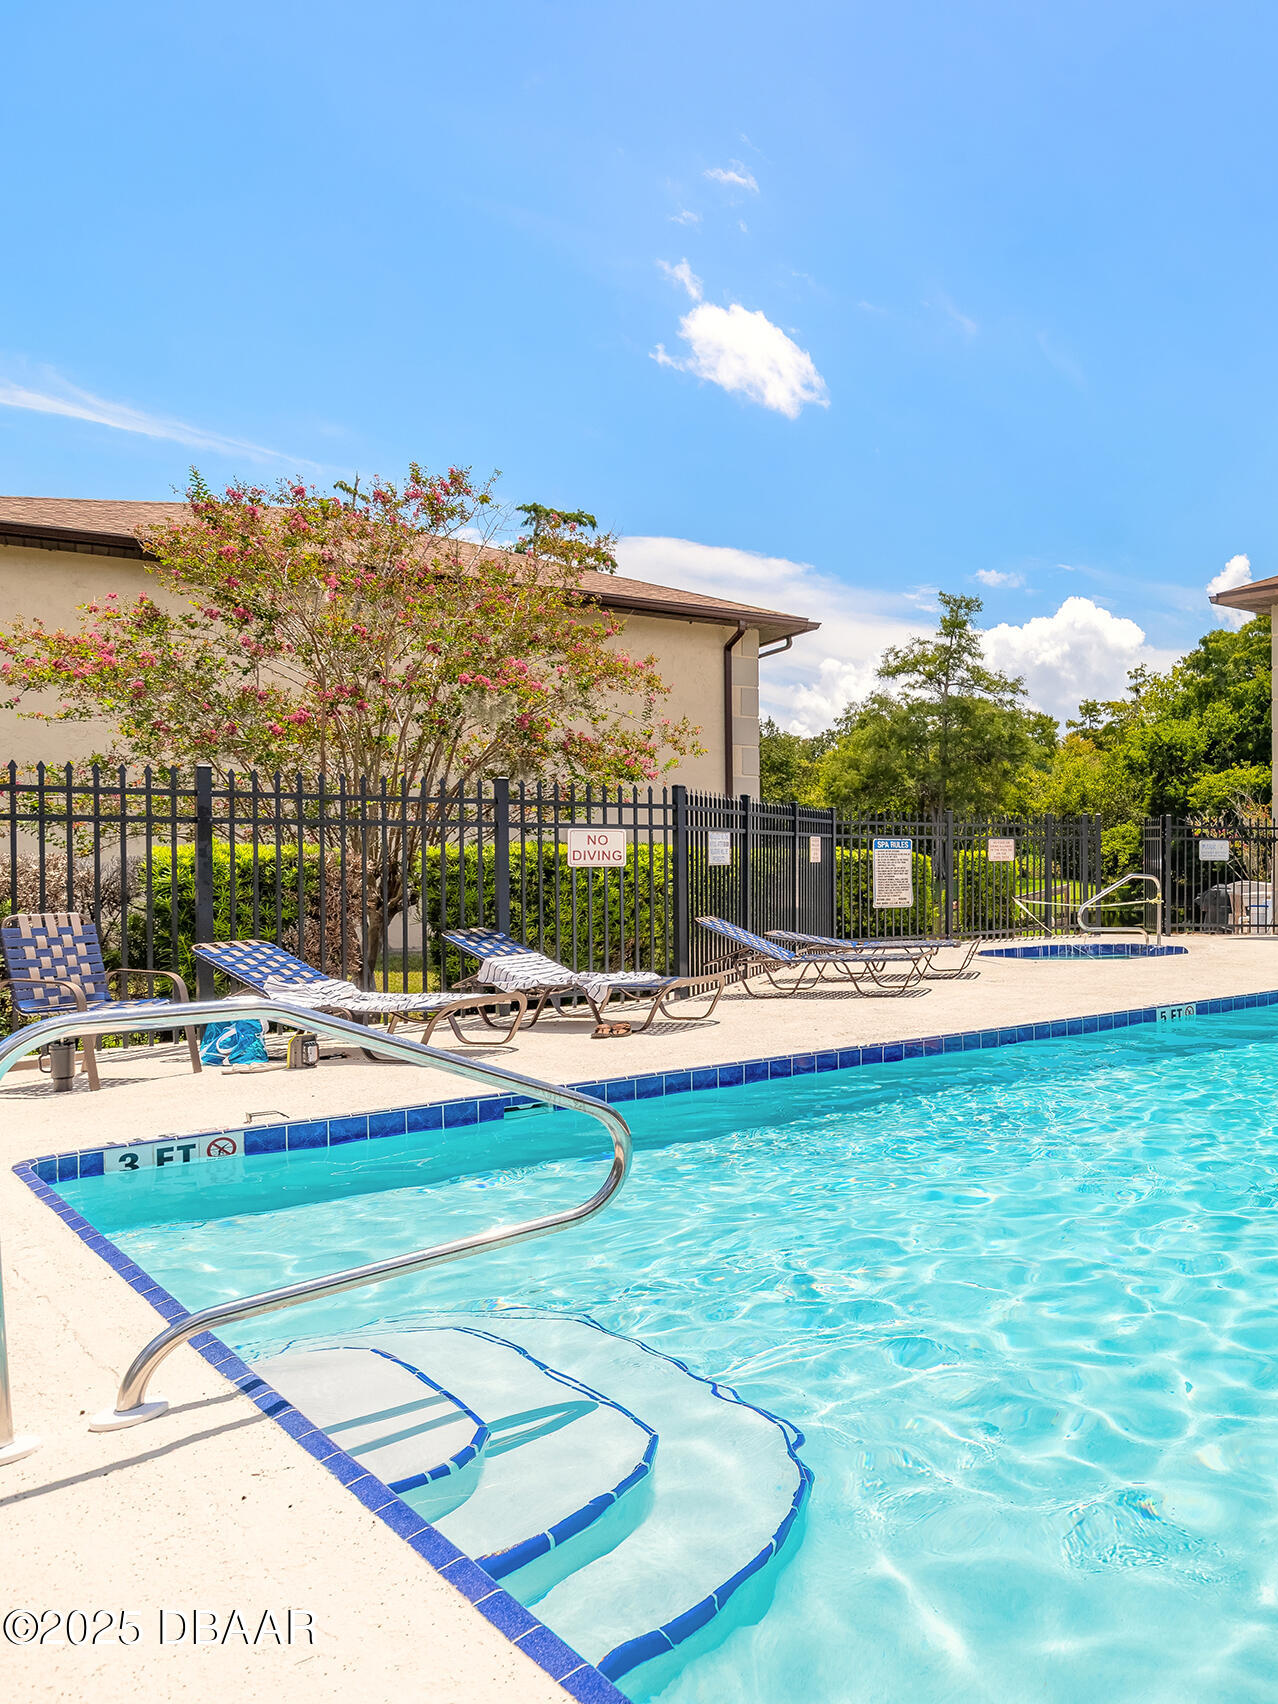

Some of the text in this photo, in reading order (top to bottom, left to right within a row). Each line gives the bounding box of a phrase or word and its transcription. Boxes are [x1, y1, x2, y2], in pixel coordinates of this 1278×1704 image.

[587, 835, 608, 845] NO
[572, 850, 622, 861] DIVING
[1160, 1008, 1182, 1021] 5 FT
[118, 1143, 197, 1171] 3 FT
